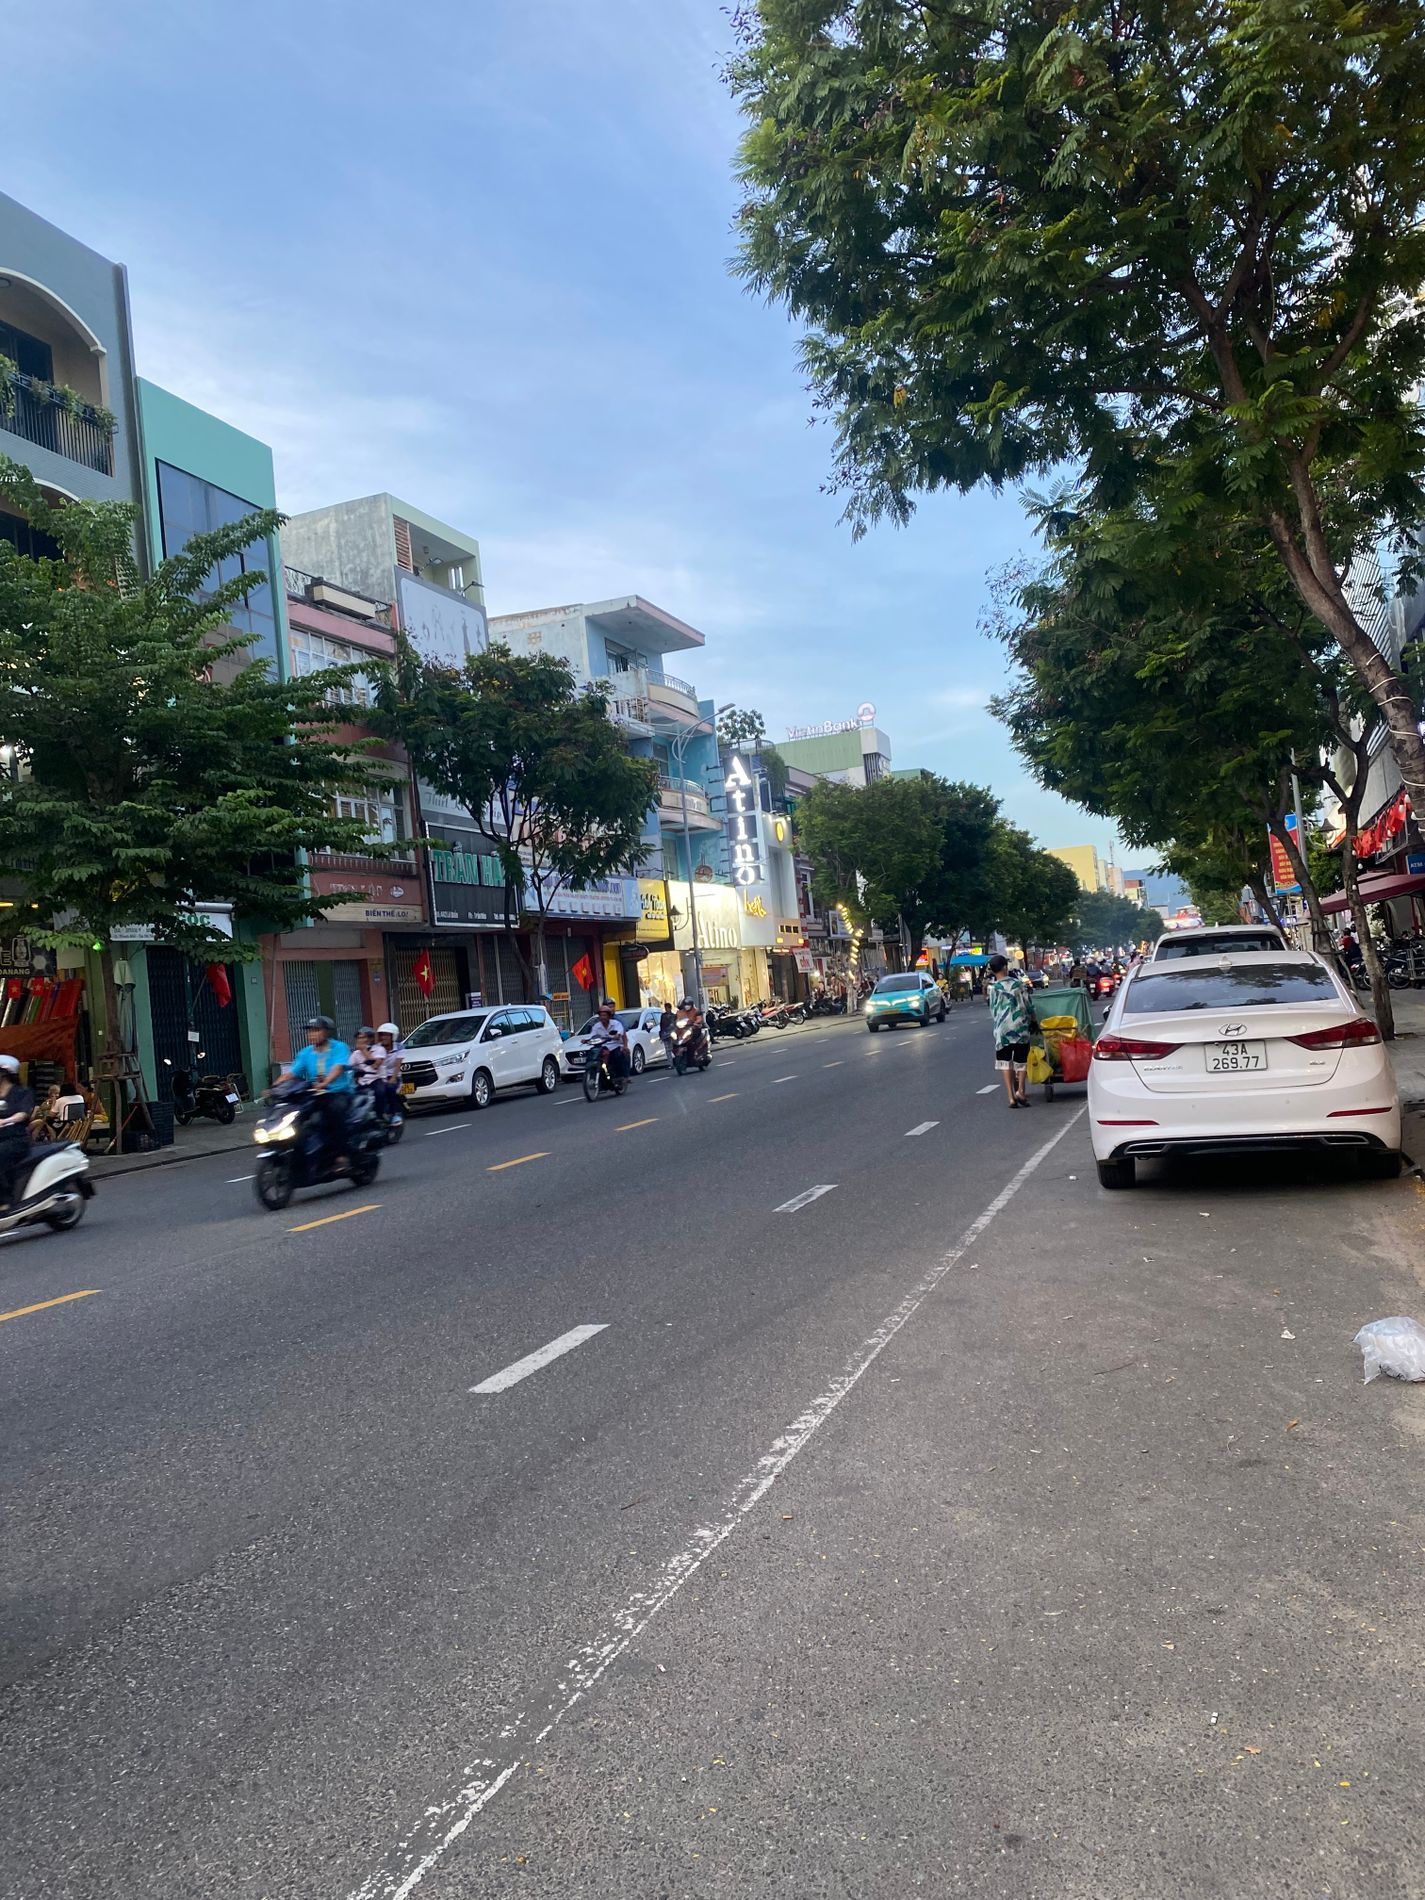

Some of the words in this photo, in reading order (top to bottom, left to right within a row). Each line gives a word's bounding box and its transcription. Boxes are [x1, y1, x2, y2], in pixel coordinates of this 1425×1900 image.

[725, 756, 755, 884] Atino
[697, 911, 737, 949] Atino
[1222, 1043, 1248, 1056] 43A
[1212, 1056, 1260, 1070] 269.77
